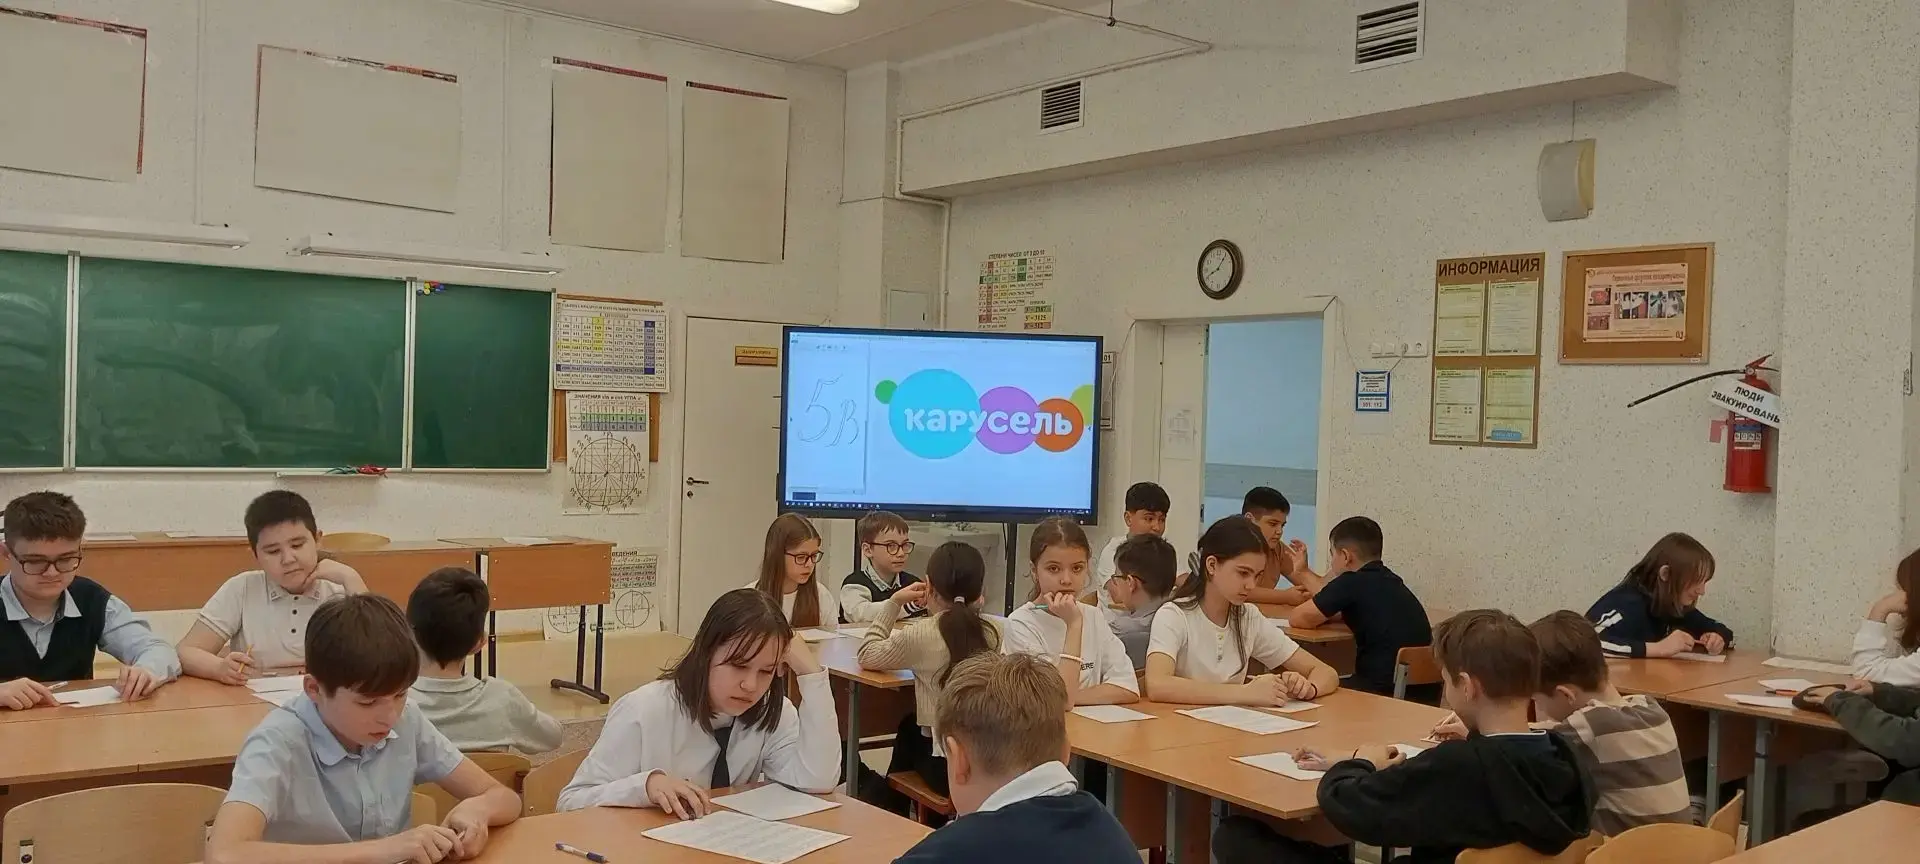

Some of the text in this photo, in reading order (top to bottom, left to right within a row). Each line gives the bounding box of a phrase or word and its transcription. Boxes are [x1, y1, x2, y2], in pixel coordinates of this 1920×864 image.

[1439, 258, 1540, 276] ИНФОРМАЦИЯ
[1734, 386, 1764, 403] ЛЮДИ
[904, 408, 1072, 436] карусель
